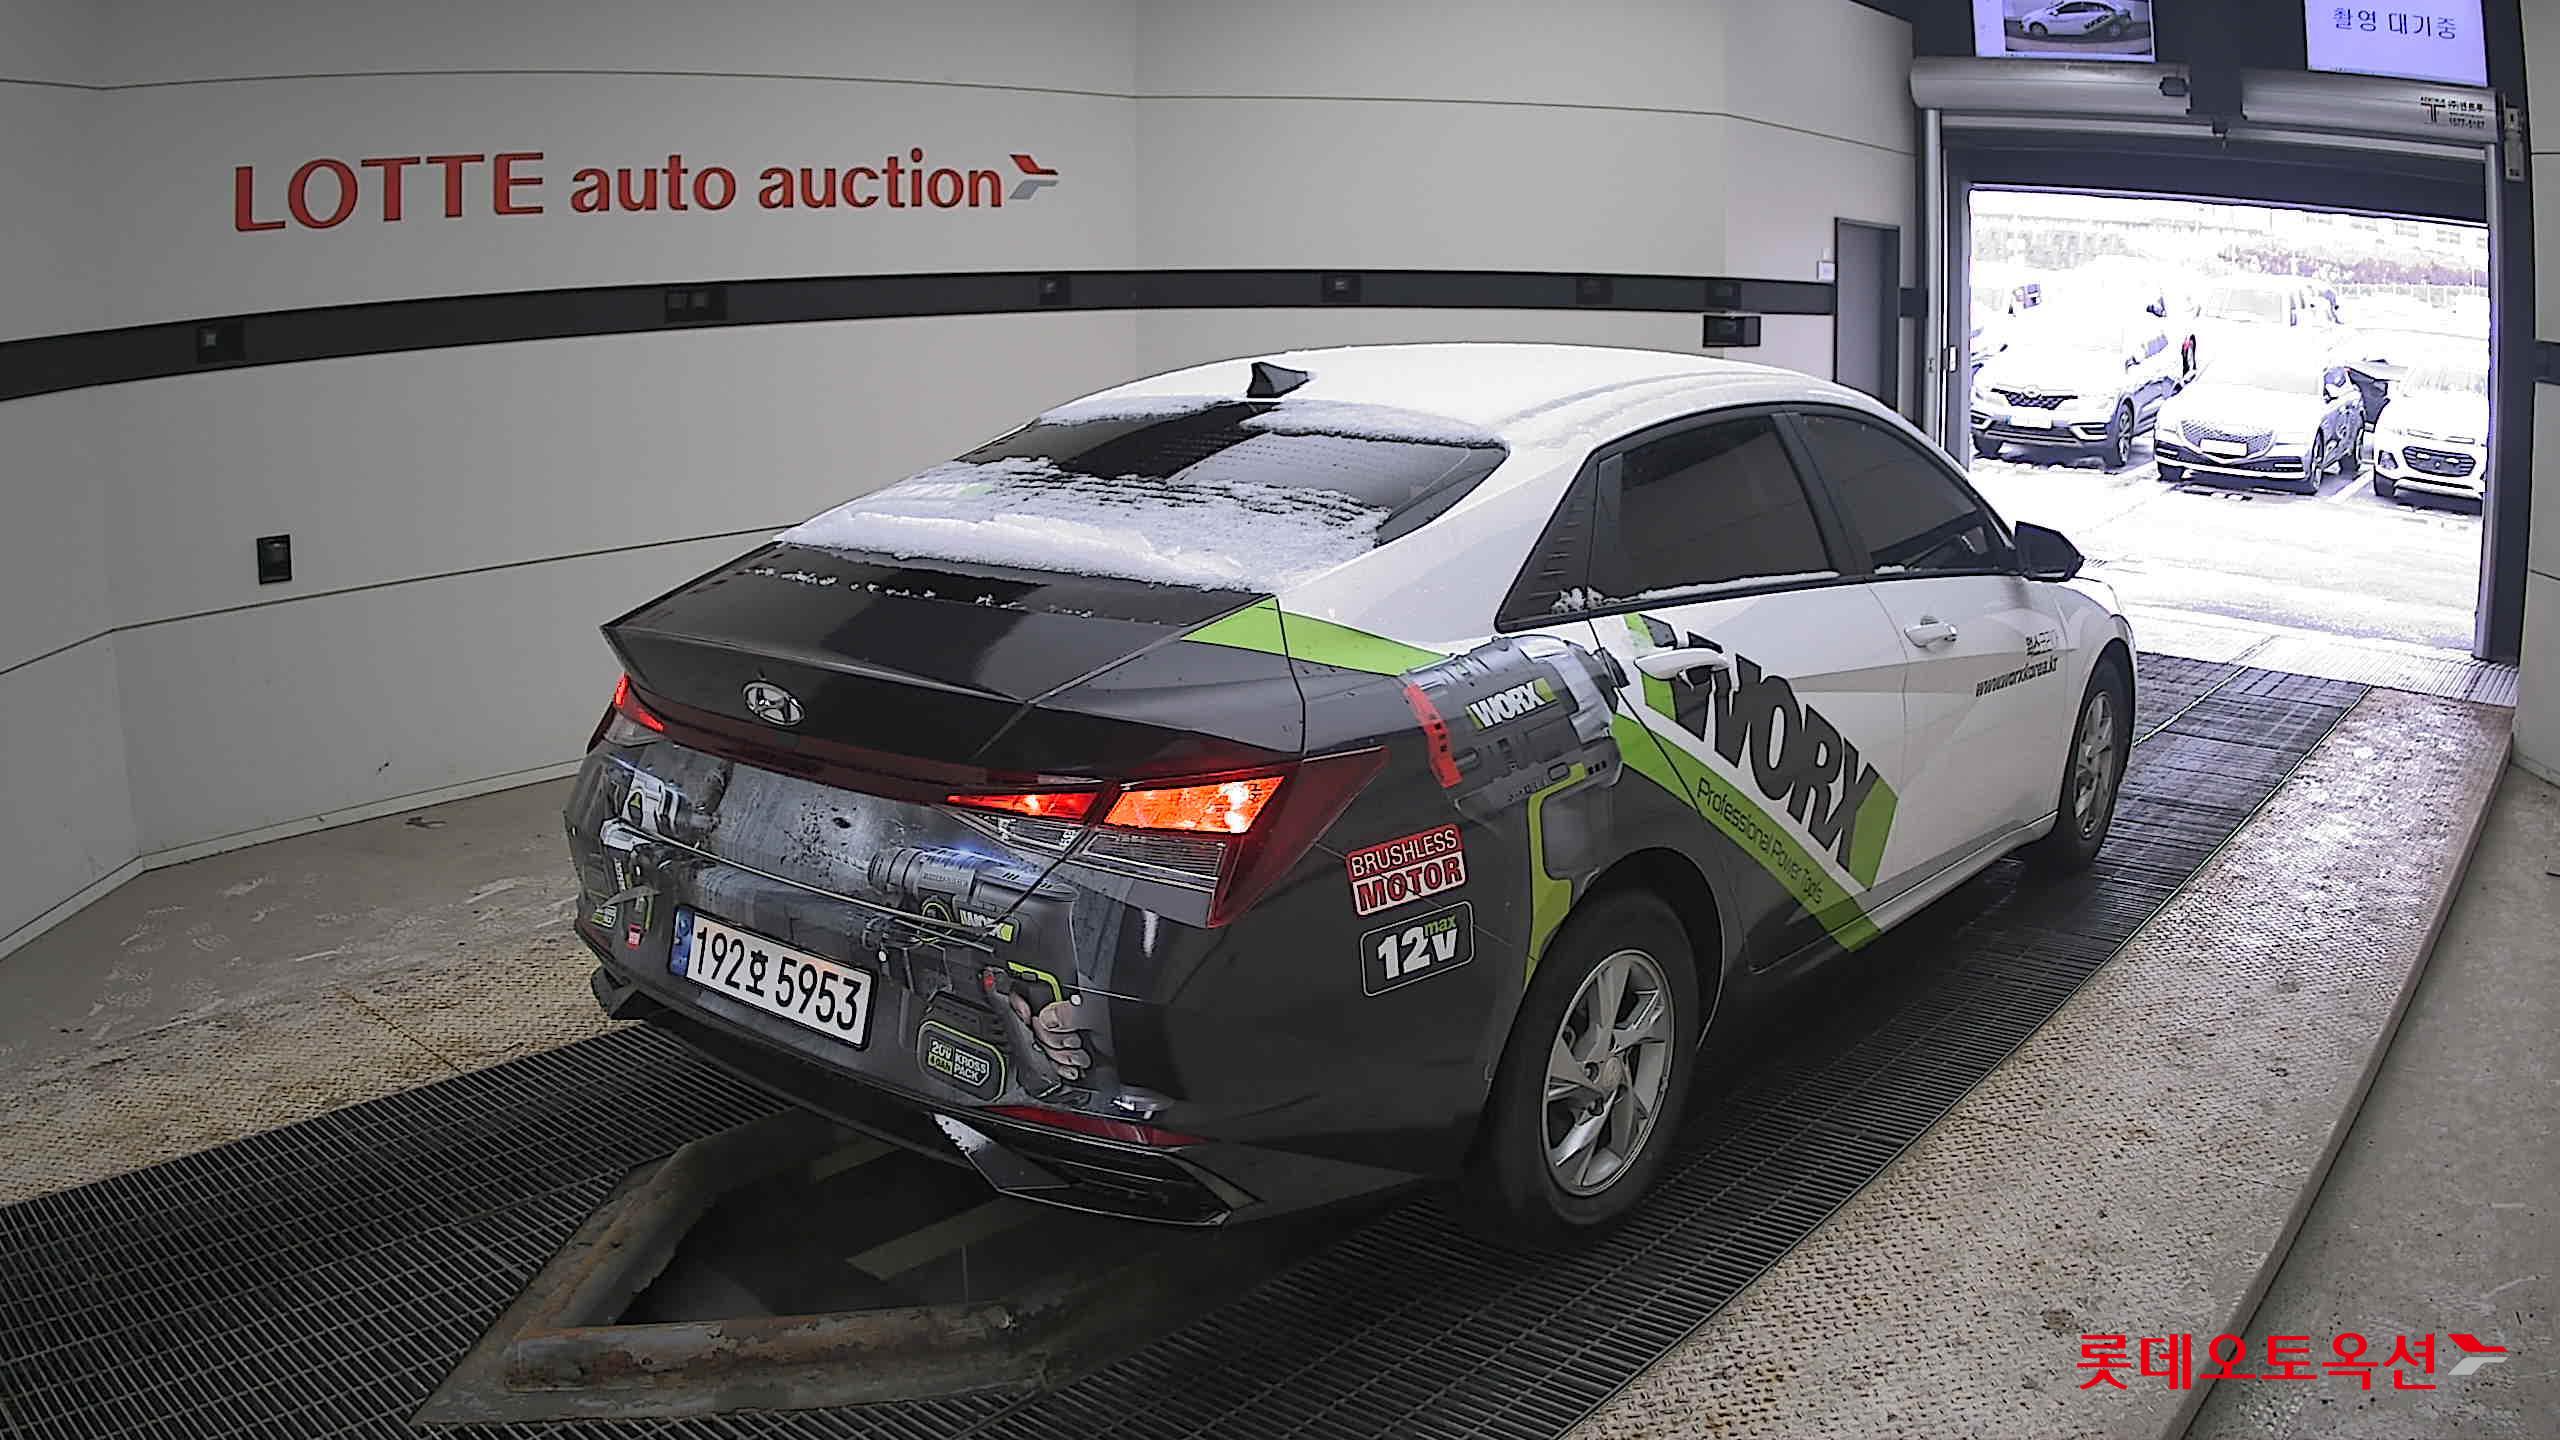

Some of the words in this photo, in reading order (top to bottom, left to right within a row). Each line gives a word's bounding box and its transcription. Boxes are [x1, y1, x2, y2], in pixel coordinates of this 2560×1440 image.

[2388, 13, 2456, 40] 대기중
[235, 152, 544, 232] LOTTE
[569, 154, 736, 214] auto
[758, 148, 1003, 209] auction
[1469, 681, 1547, 729] WORX
[1697, 777, 1775, 855] Professional
[1351, 829, 1458, 878] BRUSHLESS
[1356, 857, 1464, 912] MOTOR
[1424, 914, 1458, 937] max
[697, 926, 769, 997] 192호
[775, 955, 862, 1031] 5953
[953, 1063, 980, 1082] PACK
[954, 1052, 987, 1075] KROSS
